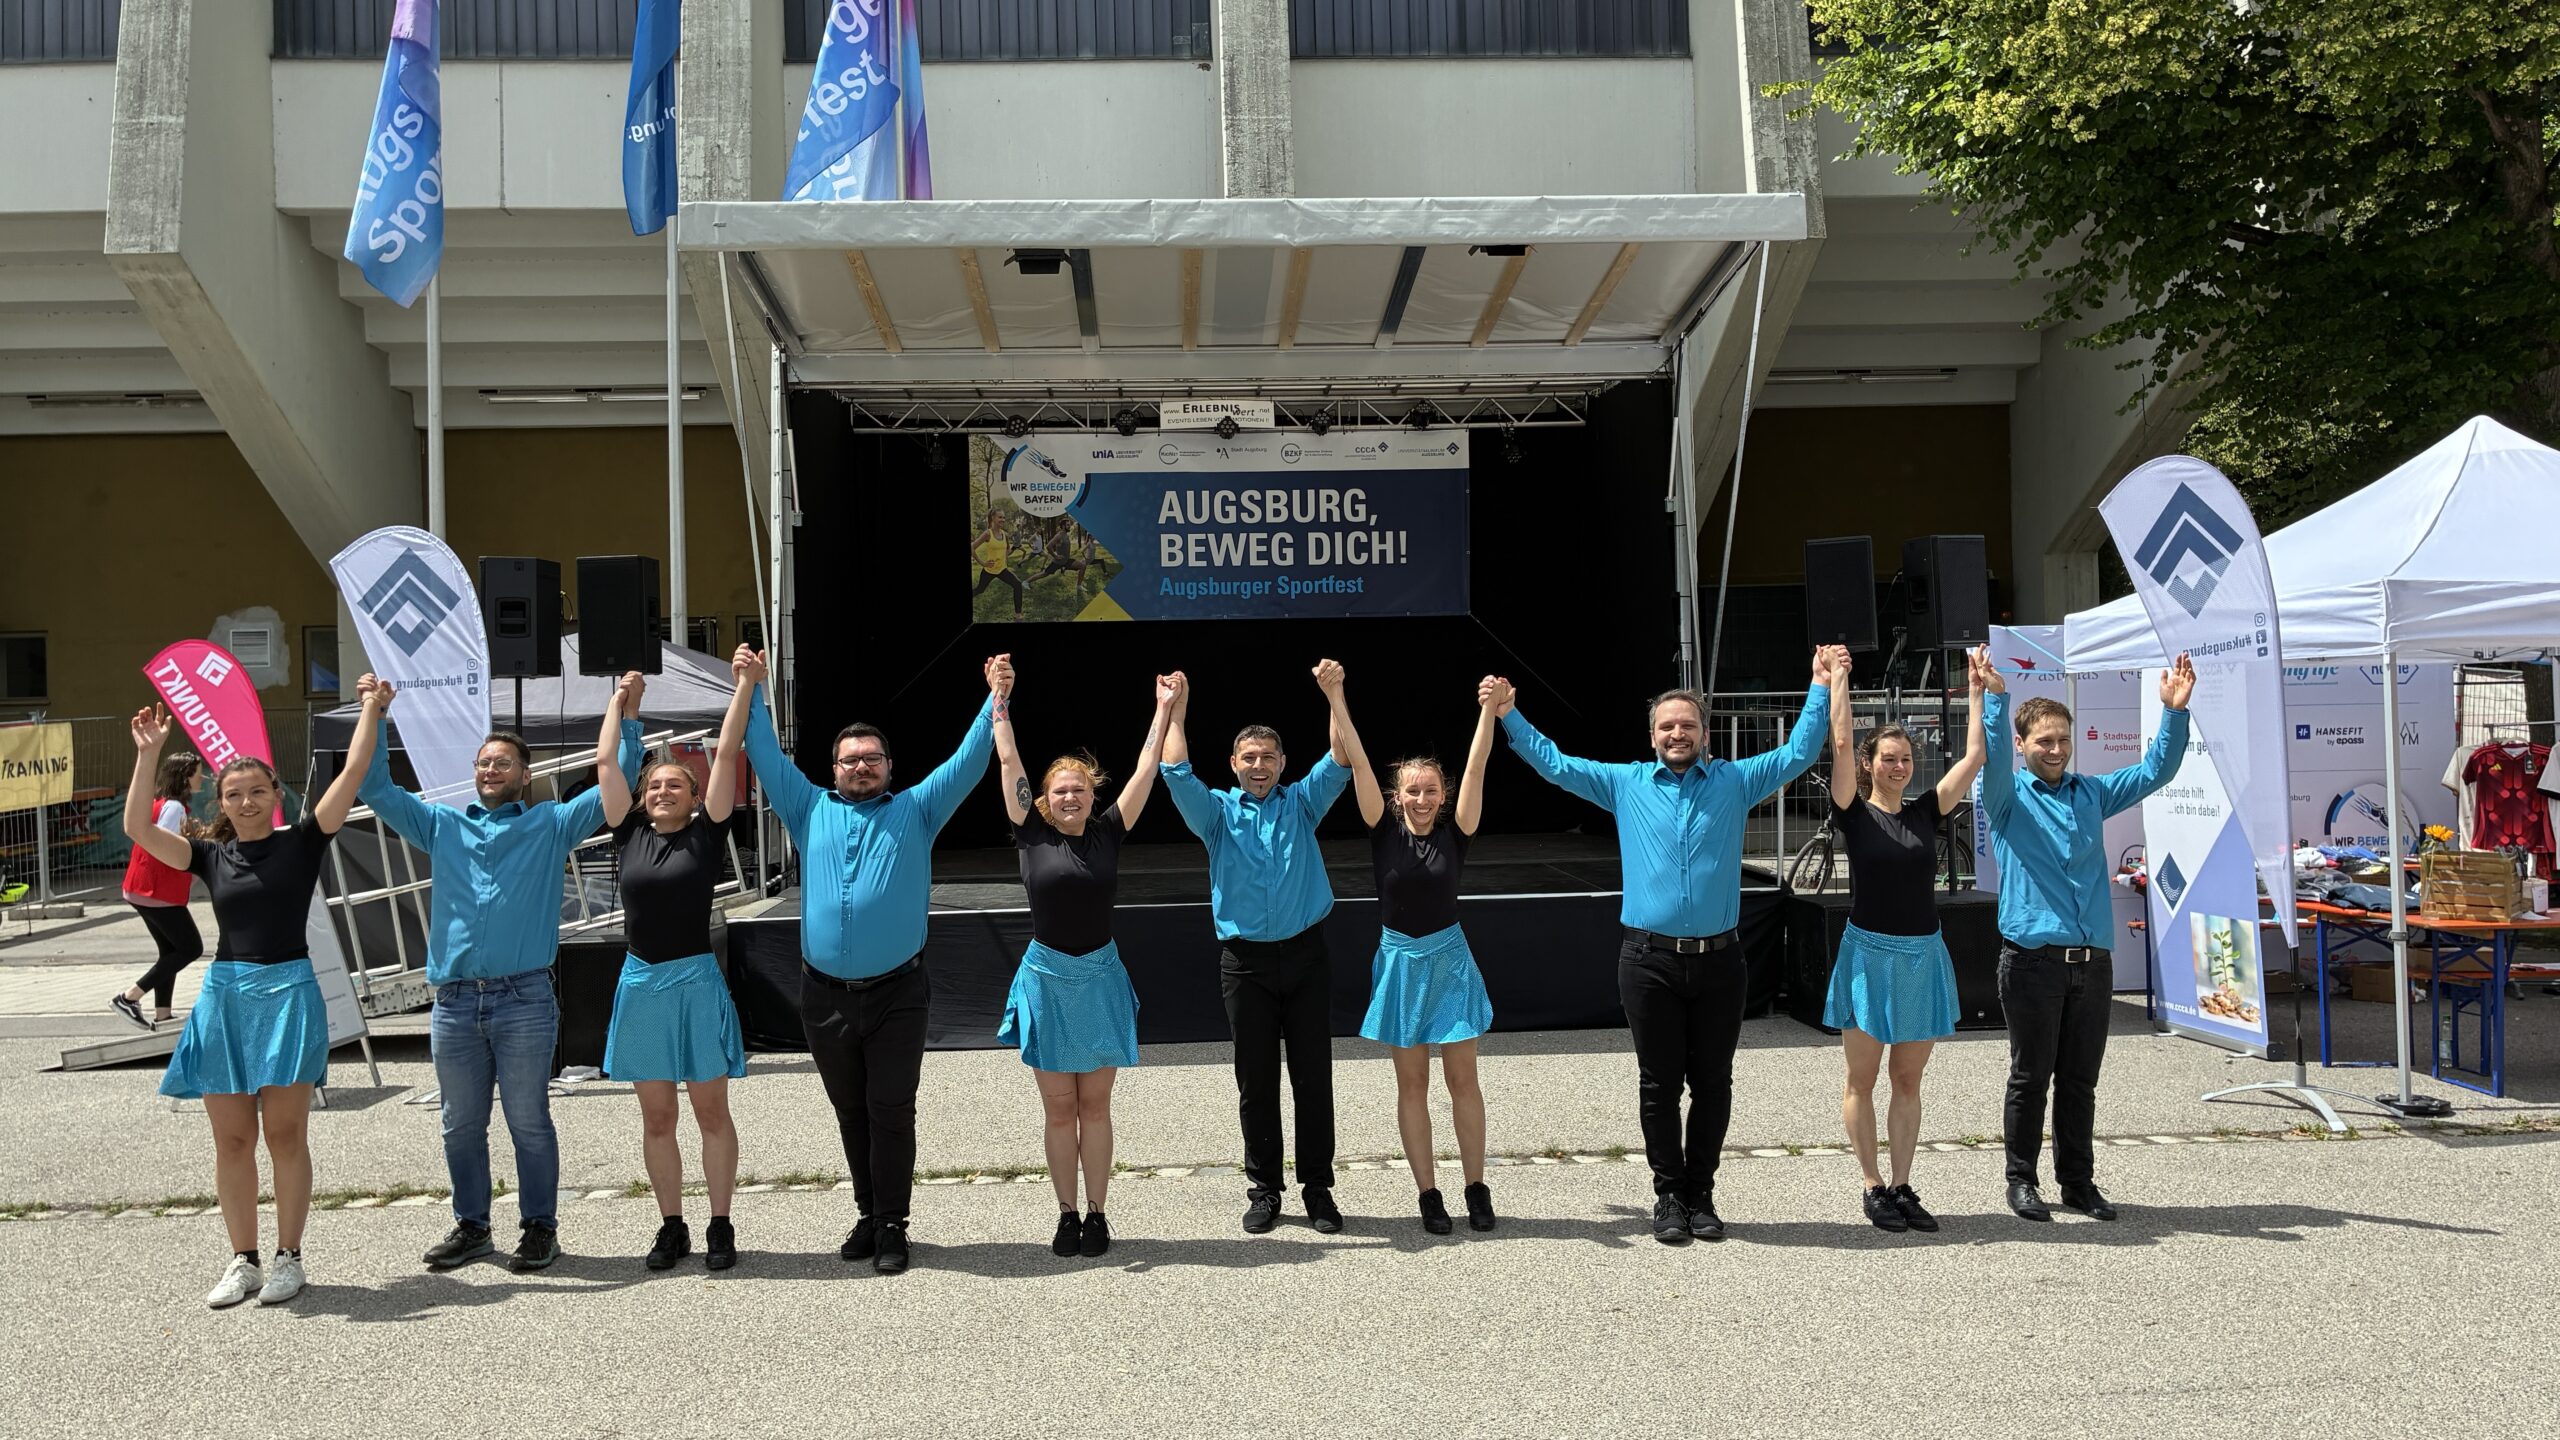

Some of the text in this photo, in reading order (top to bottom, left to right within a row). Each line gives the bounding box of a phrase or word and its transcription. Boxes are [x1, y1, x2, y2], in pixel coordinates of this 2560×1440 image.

[1355, 446, 1376, 454] CCCA
[1010, 482, 1076, 491] WIR BEWEGEN
[1024, 495, 1062, 503] BAYERN
[1158, 488, 1378, 526] AUGSBURG,
[1160, 530, 1407, 567] BEWEG DICH!
[1159, 575, 1364, 600] Augsburger Sportfest
[2315, 727, 2364, 736] HANSEFIT
[2327, 738, 2335, 746] by
[1, 756, 68, 780] TRAINING
[2165, 785, 2190, 799] Spende
[2186, 803, 2197, 815] bin
[2335, 836, 2355, 847] WIR
